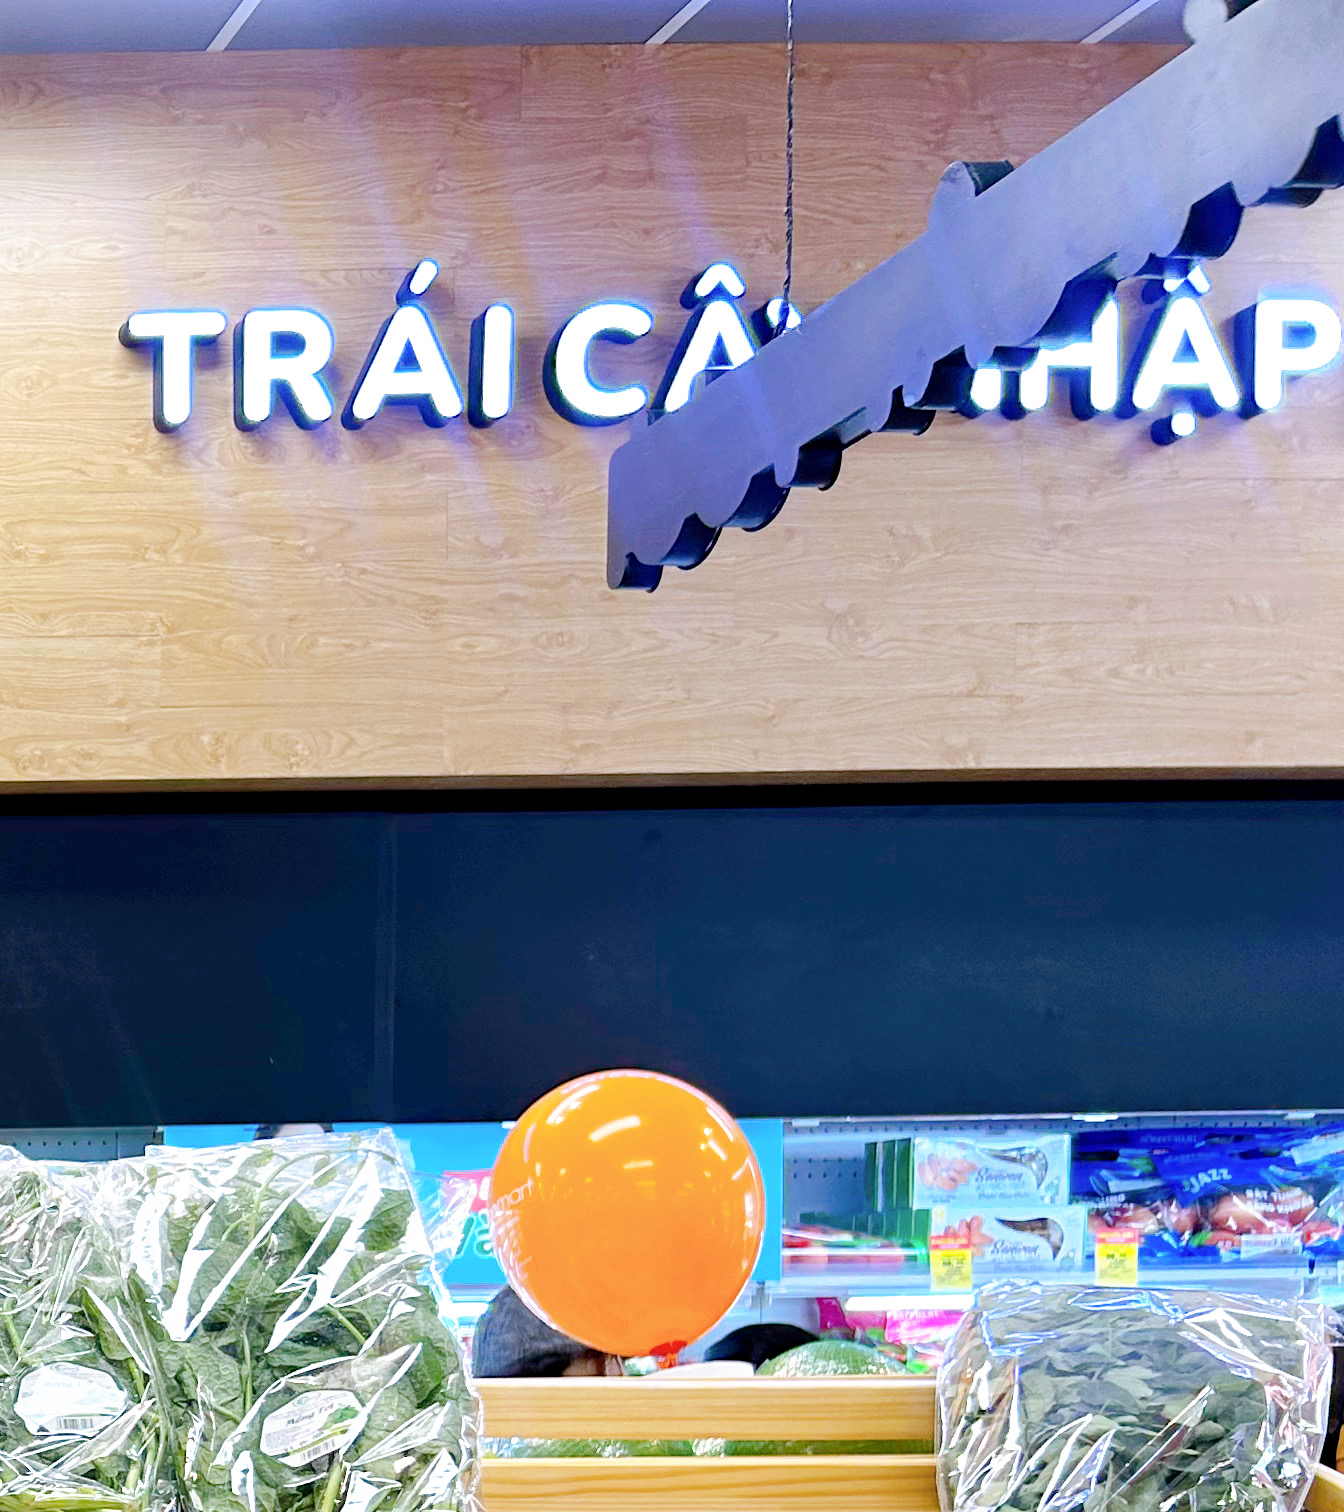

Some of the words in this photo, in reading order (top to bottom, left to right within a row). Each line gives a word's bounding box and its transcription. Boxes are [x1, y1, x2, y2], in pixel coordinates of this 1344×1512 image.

[127, 259, 514, 424] TRÁI
[550, 262, 802, 424] CÂ
[969, 262, 1343, 438] HẬP
